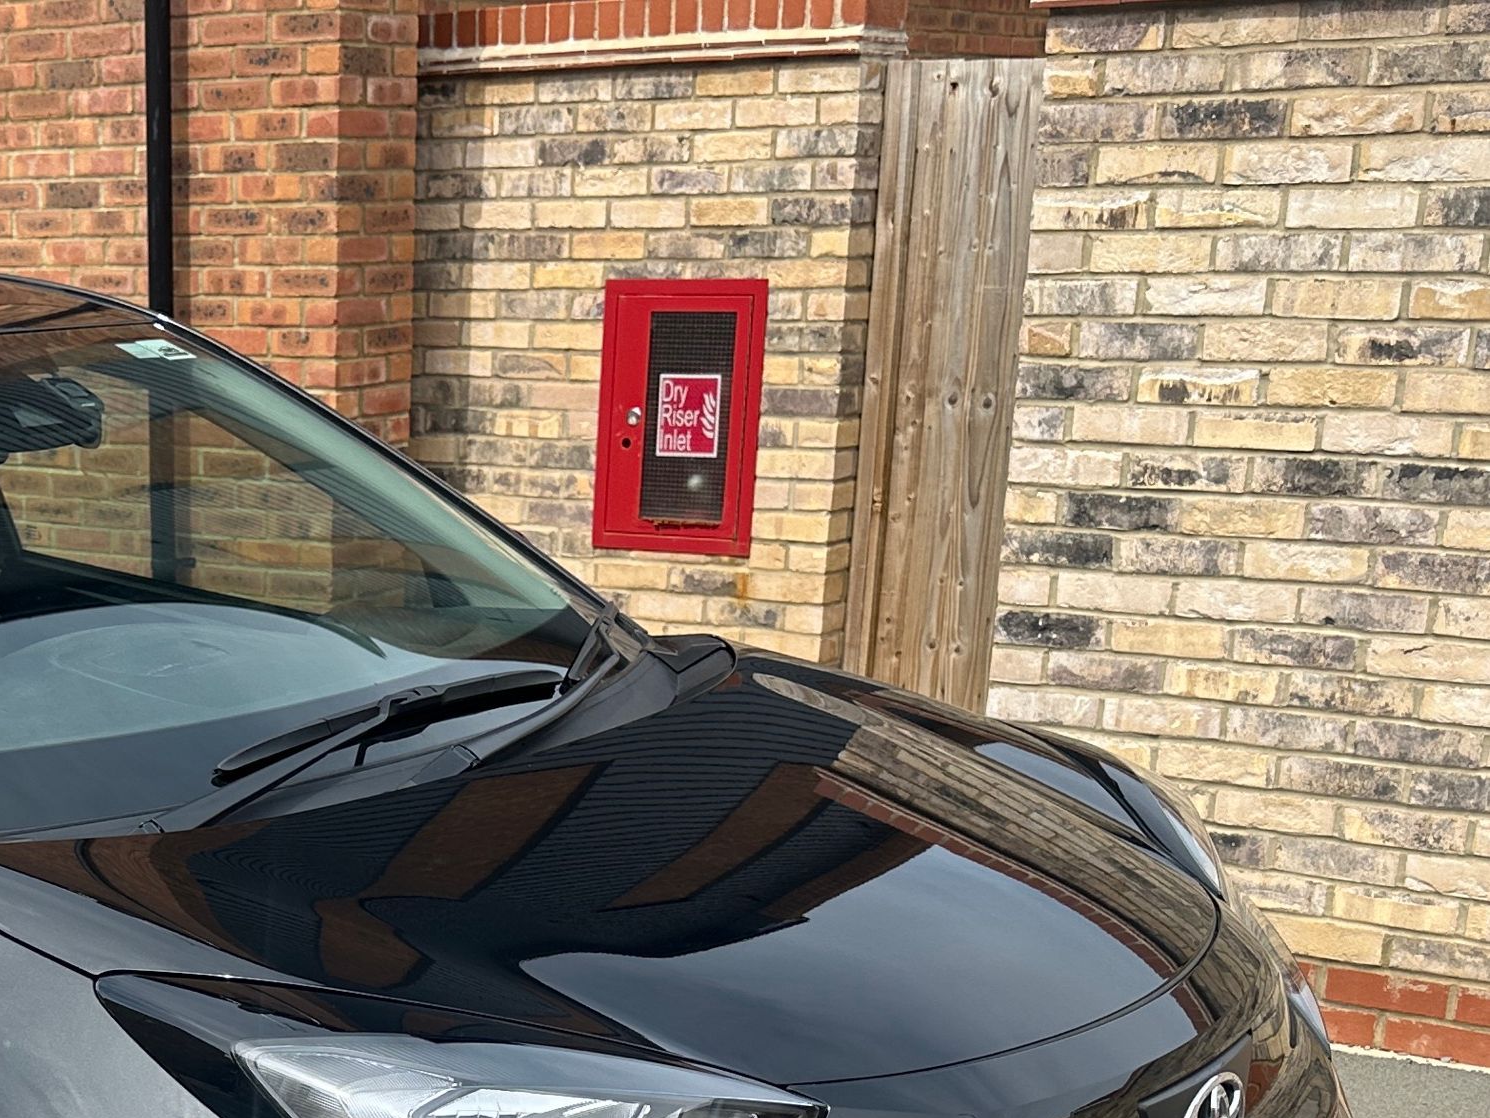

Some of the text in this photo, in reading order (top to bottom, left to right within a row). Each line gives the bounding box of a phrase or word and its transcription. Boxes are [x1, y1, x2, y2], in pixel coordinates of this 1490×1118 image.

[662, 380, 689, 408] Dry
[661, 404, 701, 427] Riser
[659, 429, 692, 451] Inlet
